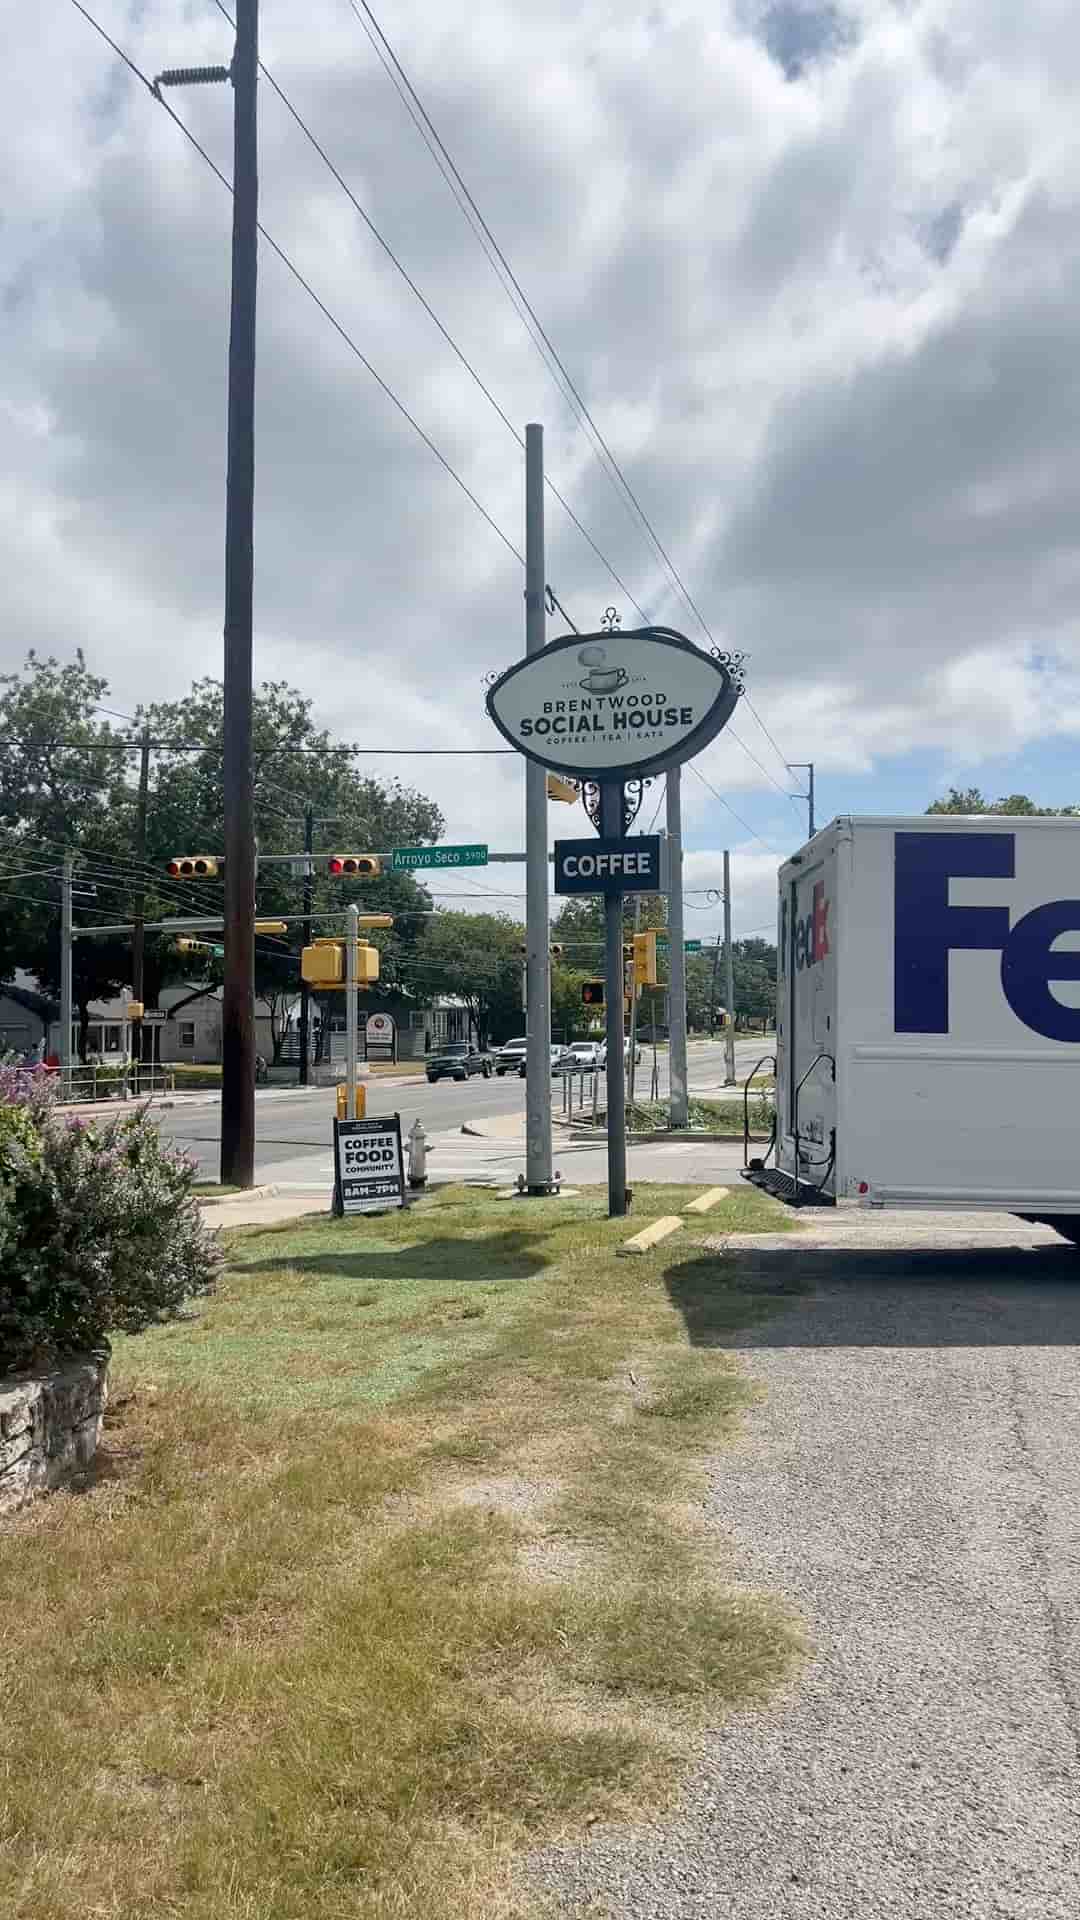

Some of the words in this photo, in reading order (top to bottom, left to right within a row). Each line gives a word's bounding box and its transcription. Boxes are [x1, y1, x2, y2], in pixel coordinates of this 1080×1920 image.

[544, 693, 667, 713] BRENTWOOD
[519, 714, 604, 737] SOCIAL
[613, 707, 693, 730] HOUSE
[546, 736, 587, 745] COFFEE
[394, 852, 431, 865] Arroyo
[435, 851, 460, 863] Seco
[563, 853, 651, 877] COFFEE
[344, 1137, 393, 1150] COFFEE
[345, 1150, 394, 1164] FOOD
[345, 1163, 394, 1174] COMMUNITY
